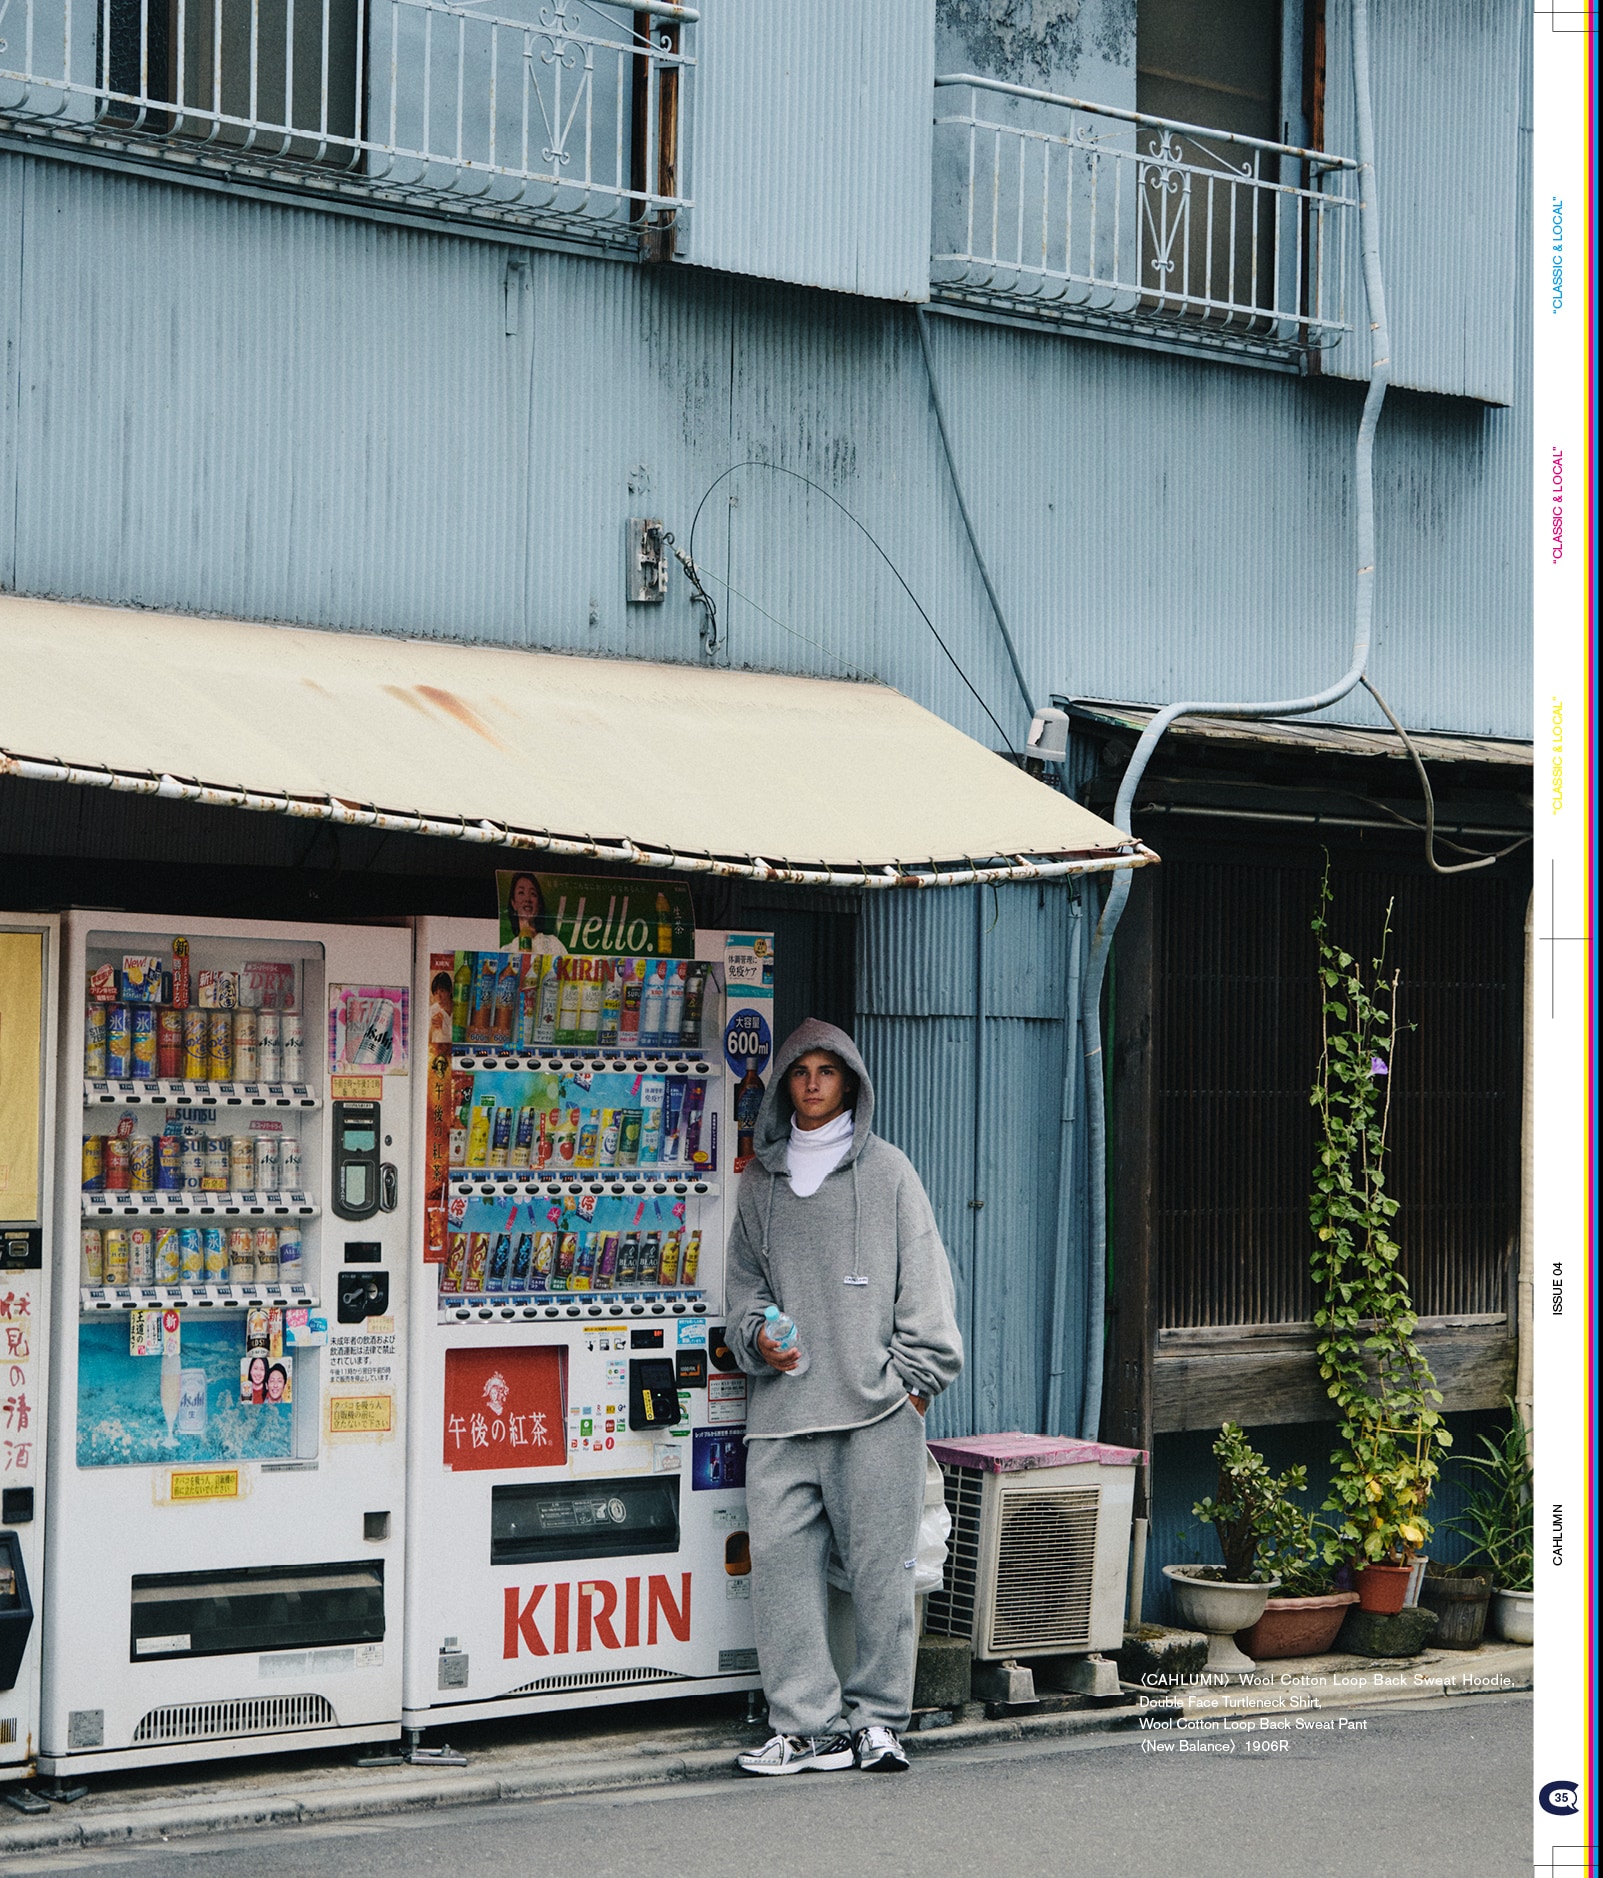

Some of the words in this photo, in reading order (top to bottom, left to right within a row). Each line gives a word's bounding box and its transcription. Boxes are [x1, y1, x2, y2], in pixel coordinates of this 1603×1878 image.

[556, 895, 653, 952] Hello.
[673, 906, 685, 935] 生茶
[124, 956, 147, 970] New!
[728, 955, 758, 965] 体調管理に
[556, 958, 617, 982] KIRIN
[728, 965, 758, 978] 免疫ケア
[109, 1015, 122, 1030] 氷
[136, 1016, 150, 1031] 氷
[736, 1017, 760, 1029] 大容量
[364, 1024, 393, 1050] Asahi
[727, 1031, 769, 1055] 600ml
[120, 1120, 131, 1136] 新
[433, 1082, 445, 1183] 午後の紅茶
[188, 1233, 198, 1247] 氷
[209, 1234, 219, 1247] 氷
[166, 1314, 177, 1329] 新
[330, 1335, 396, 1346] 未成年者の飲酒および
[330, 1345, 396, 1356] 飲酒運転は法律で禁止
[330, 1356, 372, 1366] されています。
[180, 1392, 205, 1407] Asahi
[334, 1400, 382, 1410] タバコを吸う人
[188, 1411, 195, 1419] 生
[333, 1411, 375, 1420] 自販機の前に
[333, 1420, 389, 1430] 立たないで下さい
[448, 1411, 549, 1450] 午後の紅茶
[503, 1572, 692, 1660] KIRIN
